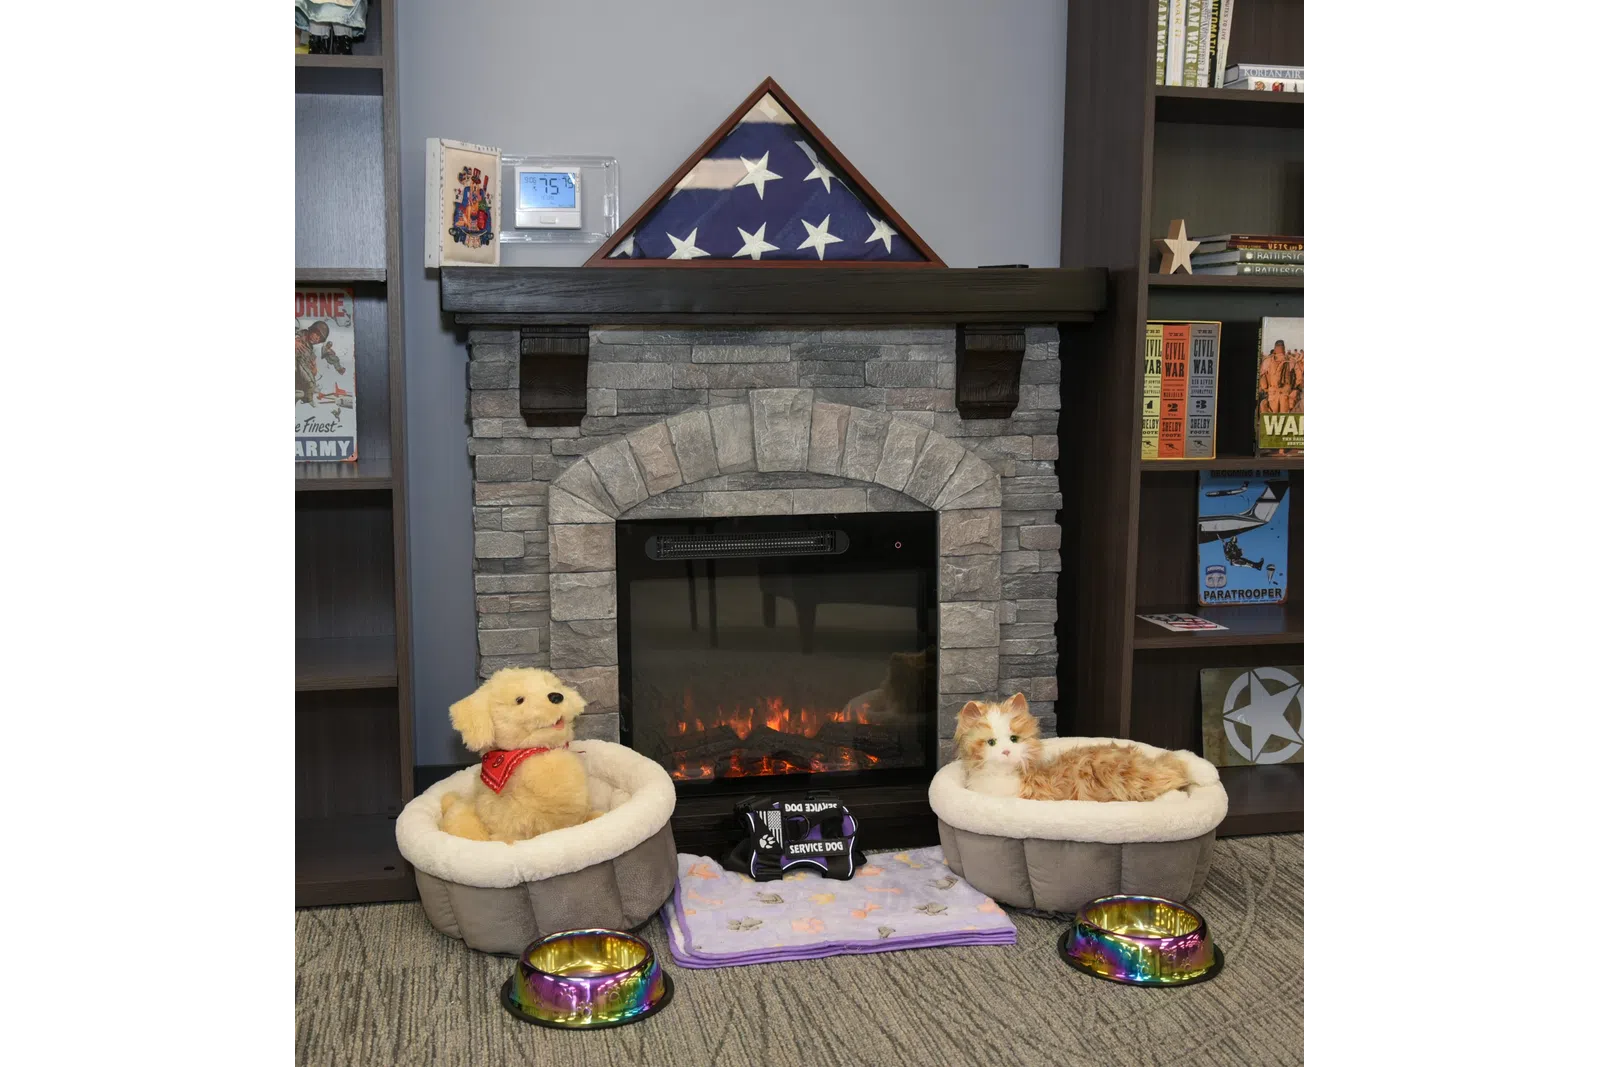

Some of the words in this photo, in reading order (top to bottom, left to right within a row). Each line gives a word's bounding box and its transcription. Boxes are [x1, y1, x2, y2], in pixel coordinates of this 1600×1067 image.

[1158, 0, 1167, 26] AM
[1157, 29, 1166, 63] WAR
[1186, 30, 1199, 64] WAR
[1244, 68, 1282, 78] KOREAN
[539, 177, 559, 195] 75
[294, 291, 345, 317] ORNE
[1146, 339, 1161, 357] IVIL
[1165, 342, 1185, 360] CIVIL
[1193, 339, 1214, 357] CIVIL
[1165, 362, 1185, 377] WAR
[1193, 359, 1214, 374] WAR
[1167, 403, 1178, 412] 2
[1195, 400, 1207, 409] 3
[1162, 421, 1182, 432] SHELBY
[1190, 419, 1210, 429] SHELBY
[295, 440, 350, 457] ARMY
[1203, 588, 1282, 600] PARATROOPER
[785, 803, 803, 812] DOG
[790, 843, 823, 854] SERVICE
[825, 841, 844, 852] DOG
